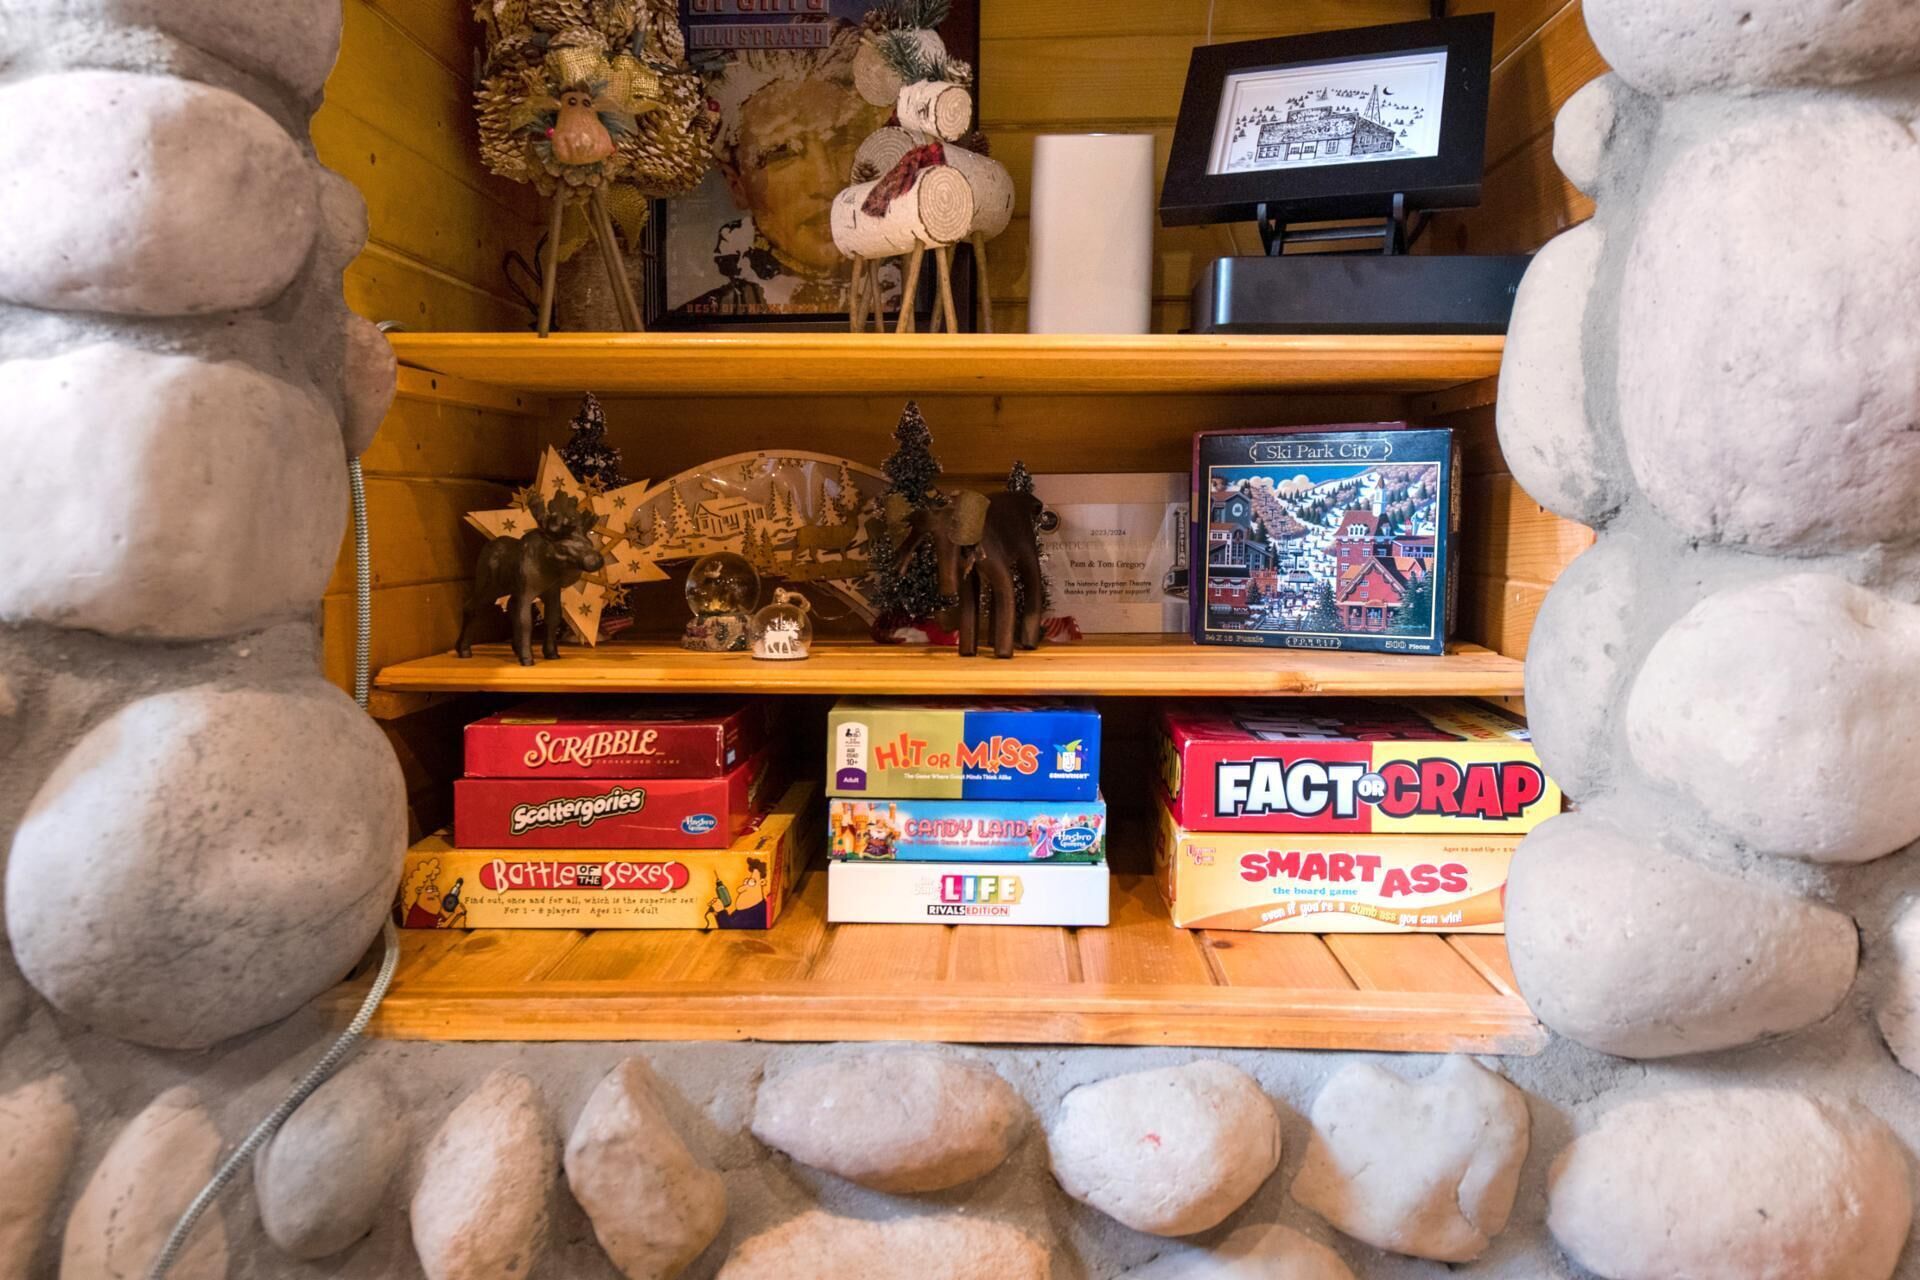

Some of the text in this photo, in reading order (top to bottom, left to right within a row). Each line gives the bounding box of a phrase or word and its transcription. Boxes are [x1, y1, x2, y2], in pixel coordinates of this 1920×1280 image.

[692, 28, 823, 46] ILLUSTRATED
[1266, 443, 1373, 459] Ski Park City
[1070, 560, 1086, 568] Pam
[1098, 560, 1114, 568] Tom
[1116, 560, 1146, 570] Gregory
[1385, 640, 1407, 649] 500
[524, 729, 658, 768] SCRABBLE
[846, 758, 858, 766] 10+
[927, 753, 951, 769] OR
[1216, 758, 1368, 818] FACT
[1357, 780, 1386, 798] OR
[1379, 758, 1544, 819] CRAP
[512, 788, 643, 832] Scattergories
[1058, 830, 1092, 841] Hasbro
[579, 865, 599, 874] OF
[1240, 850, 1382, 882] SMART
[1379, 863, 1468, 898] ASS
[493, 858, 577, 895] Battle
[579, 876, 601, 885] THE
[944, 876, 1017, 902] LIFE
[1273, 887, 1358, 898] the board game
[464, 896, 484, 904] Find
[529, 896, 545, 904] and
[549, 896, 563, 904] for
[584, 896, 610, 904] which
[623, 896, 636, 904] the
[639, 897, 677, 906] superior
[504, 906, 519, 914] For
[546, 906, 580, 917] players
[589, 906, 609, 917] Ages
[633, 906, 659, 914] Adult
[928, 905, 1008, 915] RIVALS EDITION
[1261, 907, 1286, 922] even
[1287, 901, 1296, 915] if
[1300, 900, 1334, 917] you're
[1350, 902, 1377, 918] dumb
[1379, 910, 1397, 922] ass
[1399, 913, 1418, 926] you
[1421, 914, 1438, 923] can
[1441, 909, 1463, 923] win!
